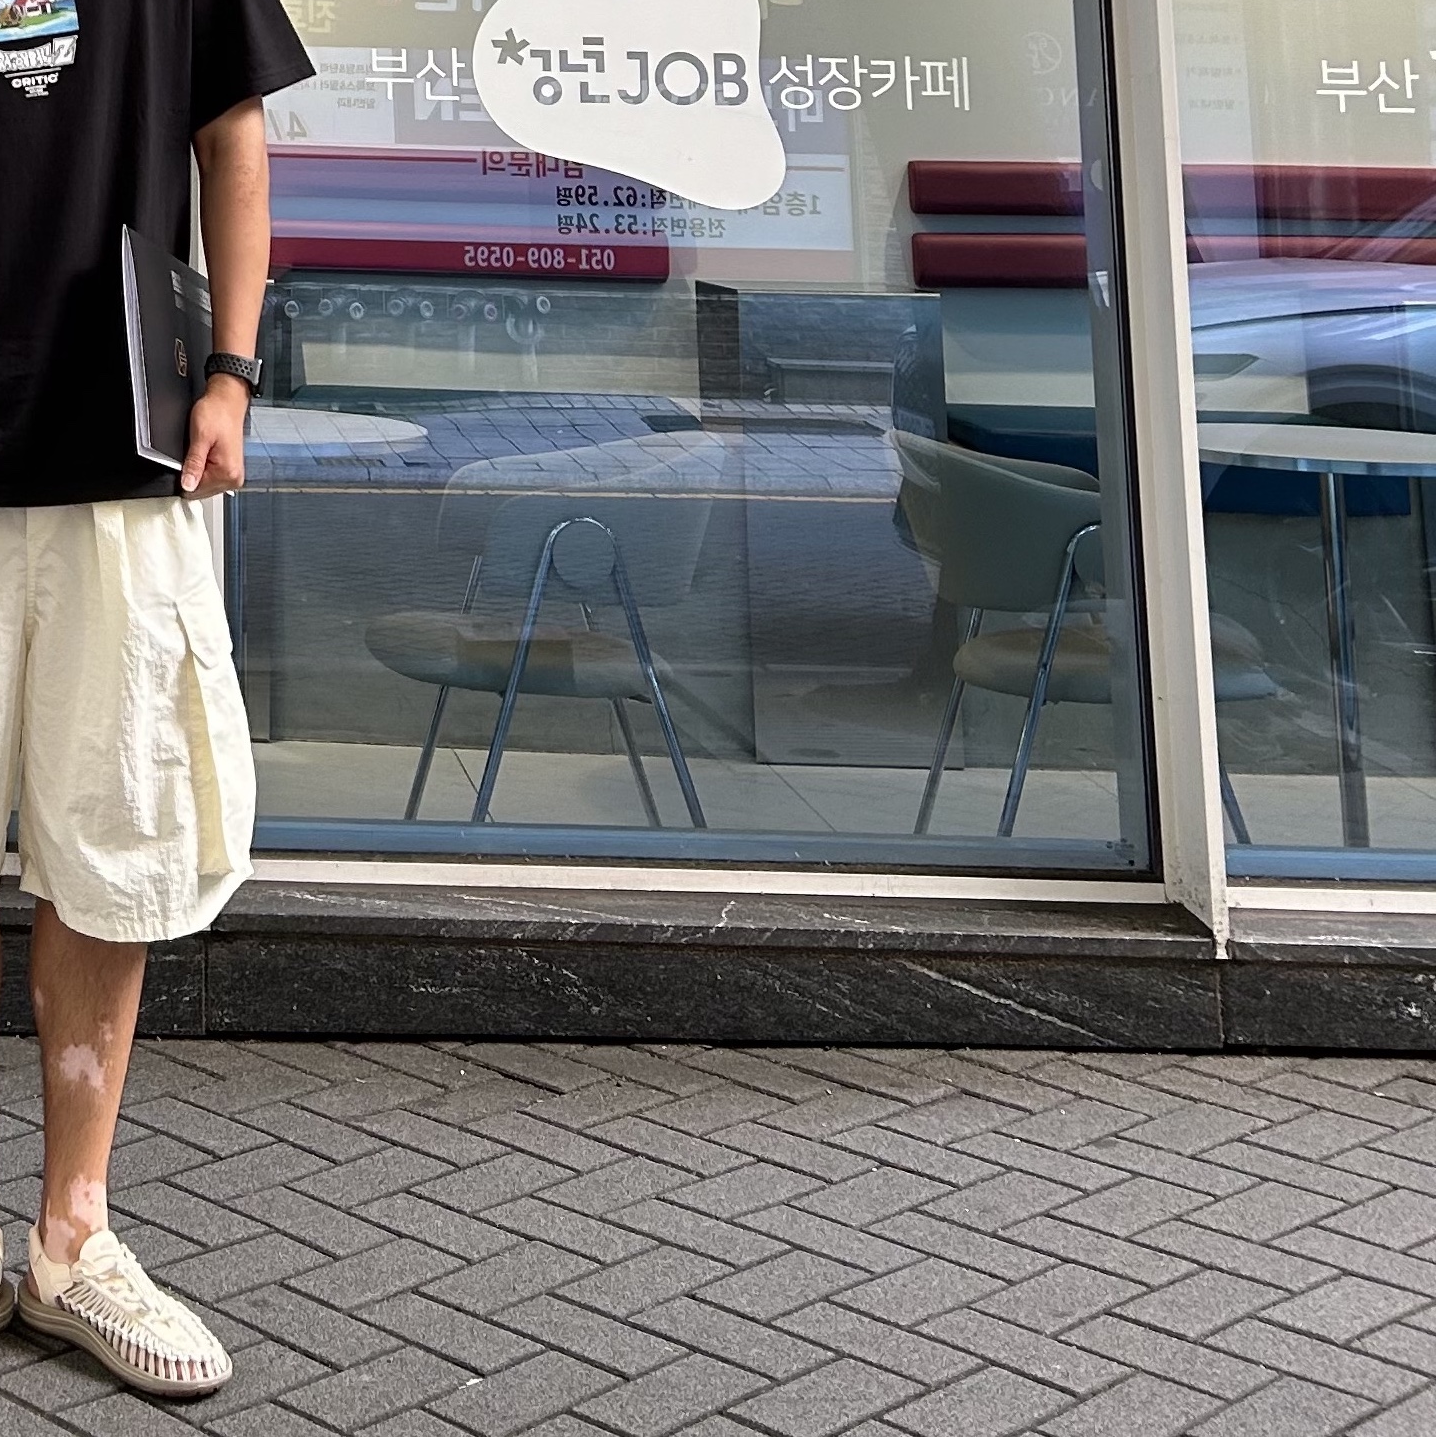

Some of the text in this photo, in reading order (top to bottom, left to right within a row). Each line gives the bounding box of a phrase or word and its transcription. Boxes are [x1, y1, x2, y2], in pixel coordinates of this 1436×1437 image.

[364, 47, 465, 101] 부산
[769, 55, 971, 111] 성장카페
[1314, 58, 1420, 114] 부산
